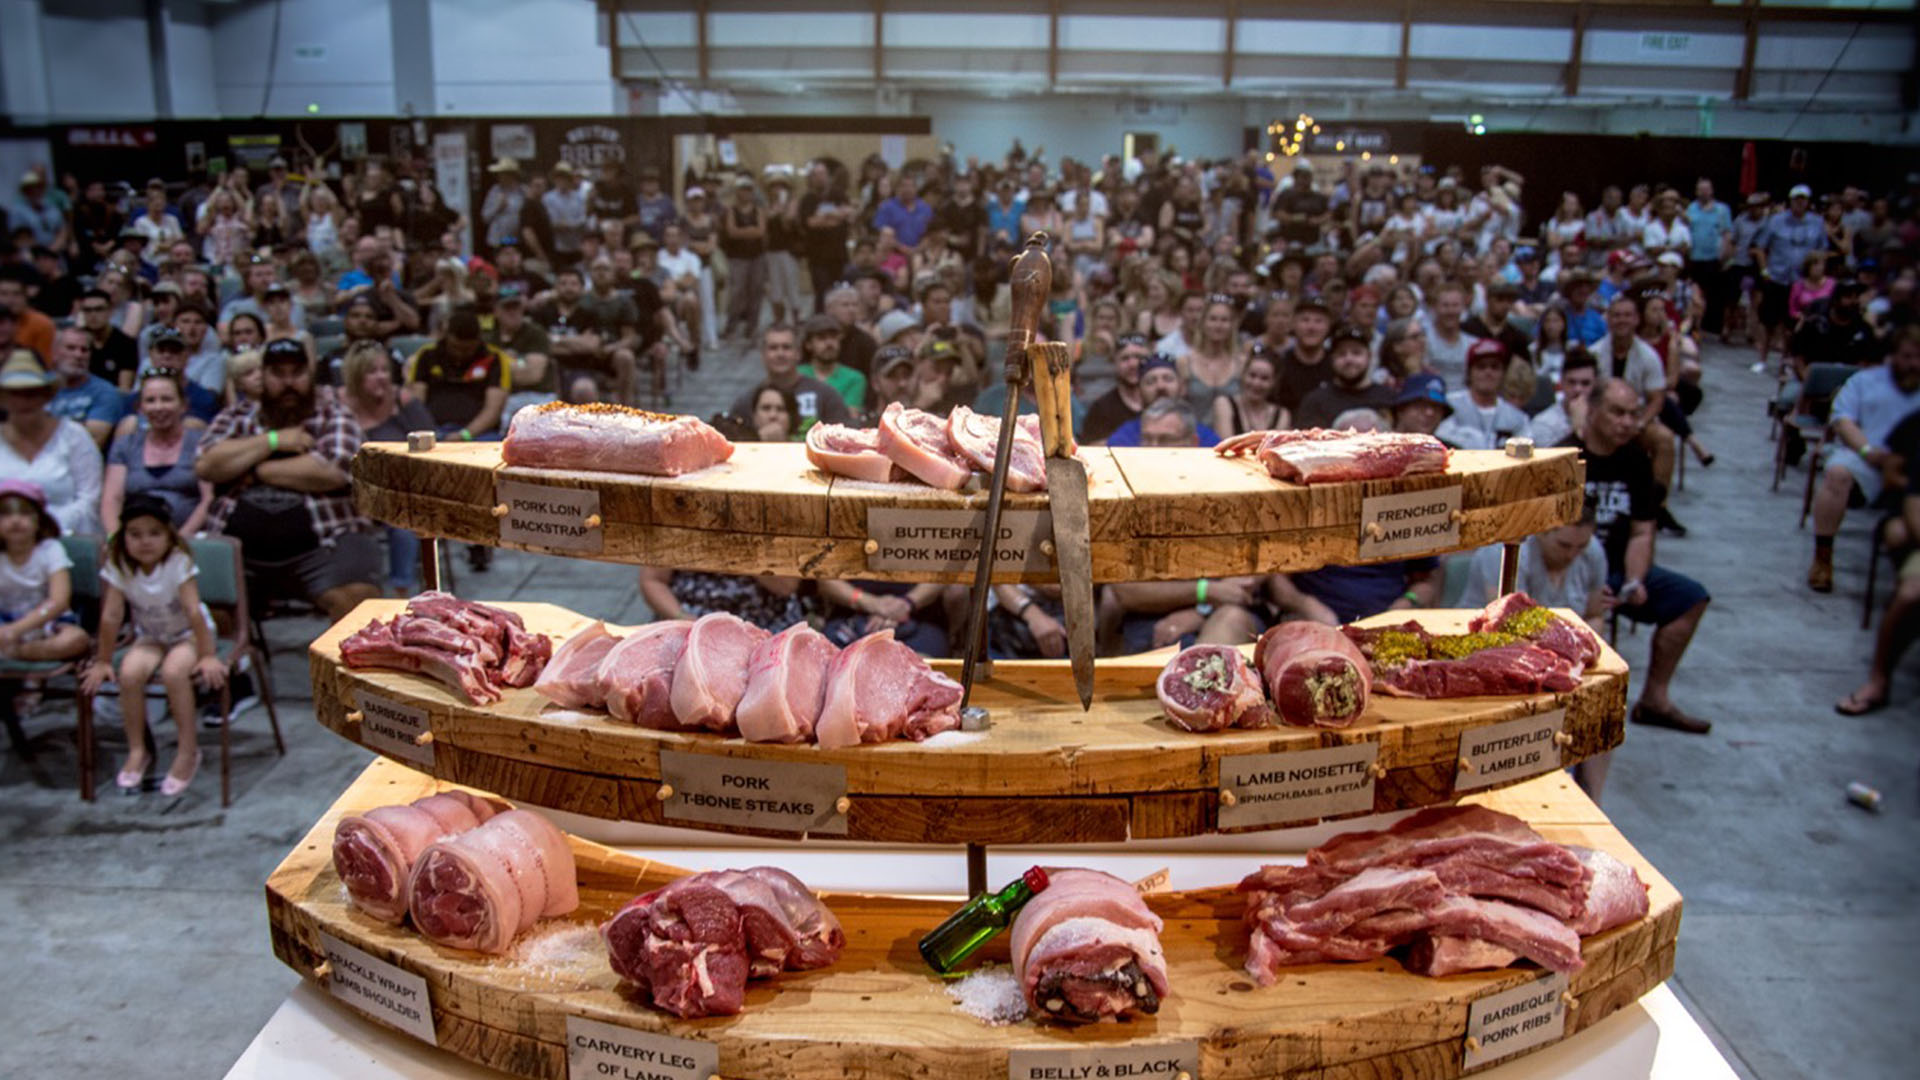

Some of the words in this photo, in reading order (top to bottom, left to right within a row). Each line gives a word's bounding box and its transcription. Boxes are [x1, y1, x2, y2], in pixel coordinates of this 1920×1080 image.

[1641, 33, 1663, 49] FIRE
[1666, 34, 1692, 51] EXIT
[513, 500, 547, 514] PORK
[550, 504, 582, 517] LOIN
[1377, 503, 1448, 522] FRENCHED
[511, 519, 588, 537] BACKSTRAP
[895, 527, 1013, 539] BUTTERFLD
[1374, 528, 1412, 543] LAMB
[1414, 523, 1448, 539] RACK
[883, 548, 930, 560] PORK
[364, 701, 420, 728] BARBEQUE
[369, 721, 396, 739] LAMB
[1472, 728, 1552, 757] BUTTERFLIED
[1236, 771, 1285, 787] LAMB
[1289, 760, 1366, 782] NOISETTE
[1480, 758, 1516, 775] LAMB
[1518, 752, 1541, 766] LEG
[722, 774, 770, 790] PORK
[1325, 784, 1333, 794] &
[1335, 781, 1361, 793] FETA
[681, 791, 742, 810] T-BONE
[746, 799, 815, 816] STEAKS
[329, 952, 376, 983] CRACKLE
[333, 969, 361, 994] LAMB
[362, 986, 421, 1022] SHOULDER
[1483, 990, 1556, 1026] BARBEQUE
[1482, 1023, 1520, 1047] PORK
[1521, 1012, 1552, 1032] RIBS
[575, 1035, 656, 1062] CARVERY
[660, 1052, 697, 1070] LEG
[597, 1062, 621, 1076] OF
[1030, 1066, 1092, 1080] BELLY
[1096, 1065, 1110, 1078] &
[1114, 1059, 1181, 1077] BLACK
